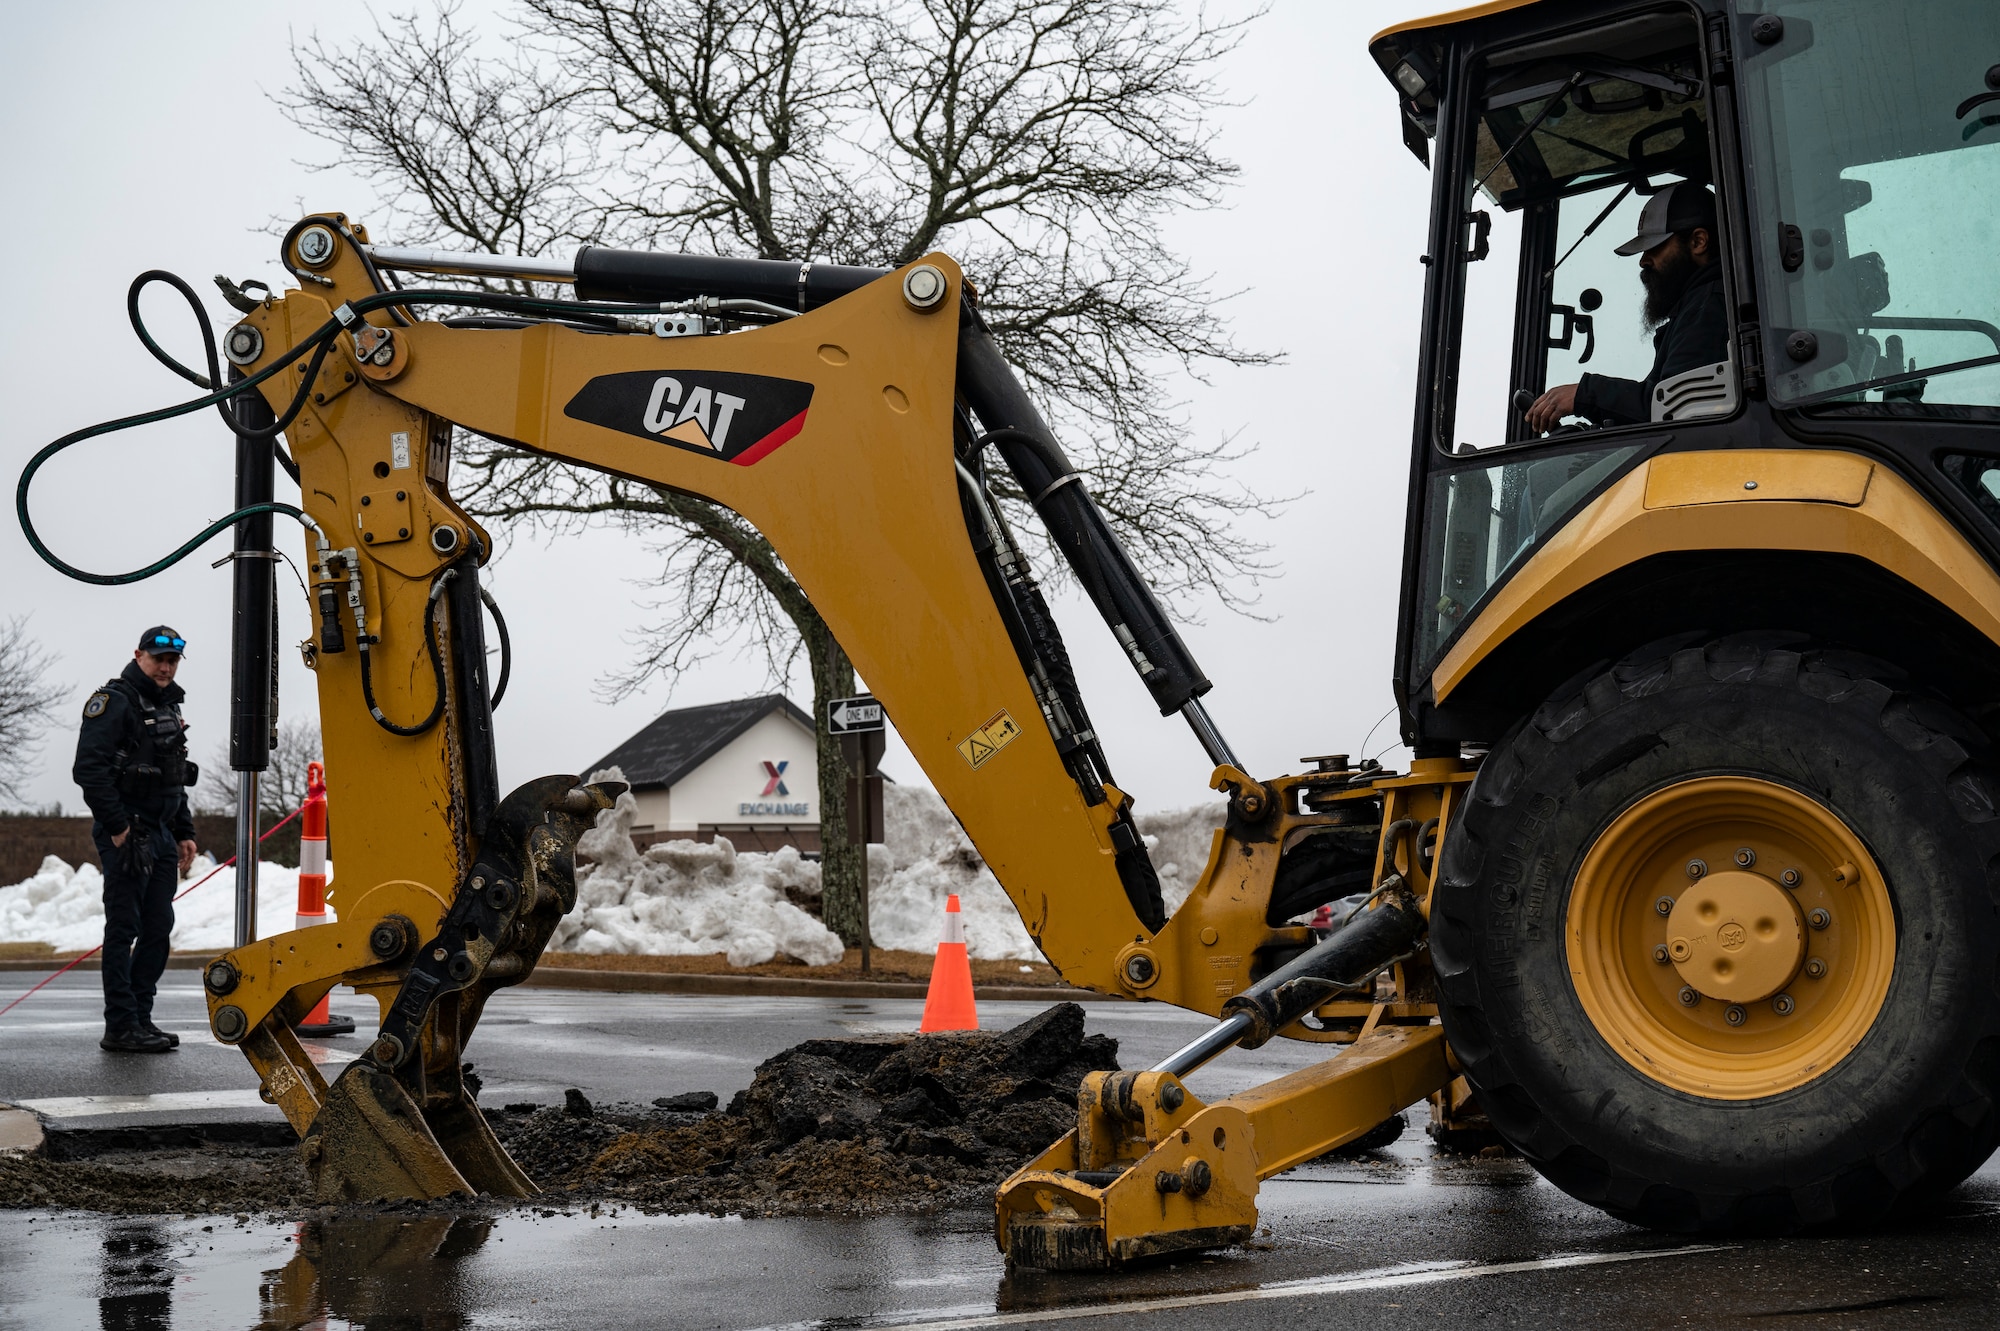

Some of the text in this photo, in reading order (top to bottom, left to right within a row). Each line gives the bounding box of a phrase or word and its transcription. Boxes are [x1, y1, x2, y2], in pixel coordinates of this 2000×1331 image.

[643, 376, 746, 452] CAT
[846, 706, 878, 722] ONE WAY
[739, 803, 809, 816] EXCHANGE
[1487, 790, 1559, 990] HERCULES
